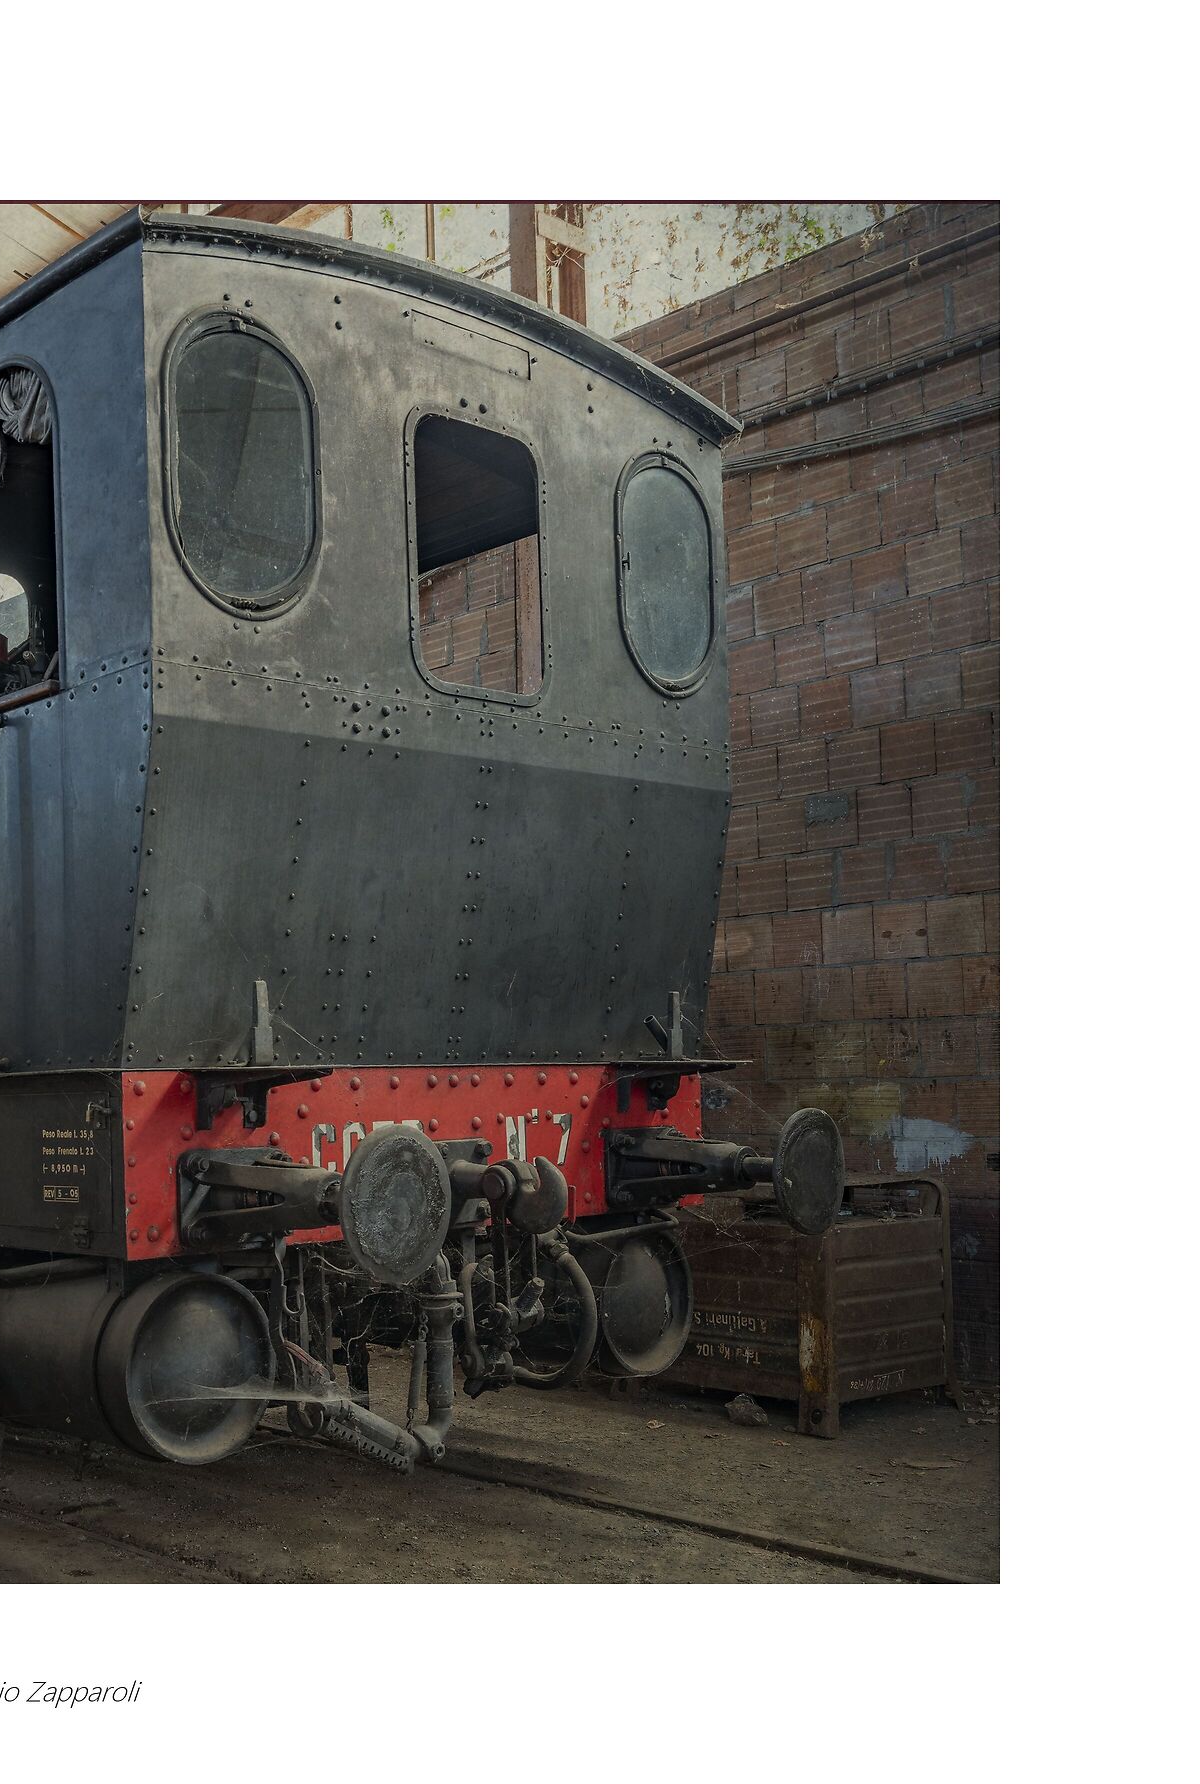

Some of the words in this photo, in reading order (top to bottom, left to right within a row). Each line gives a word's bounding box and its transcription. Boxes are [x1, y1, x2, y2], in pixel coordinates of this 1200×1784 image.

[42, 1129, 56, 1139] Peso
[42, 1146, 56, 1156] Peso
[85, 1146, 94, 1156] 23
